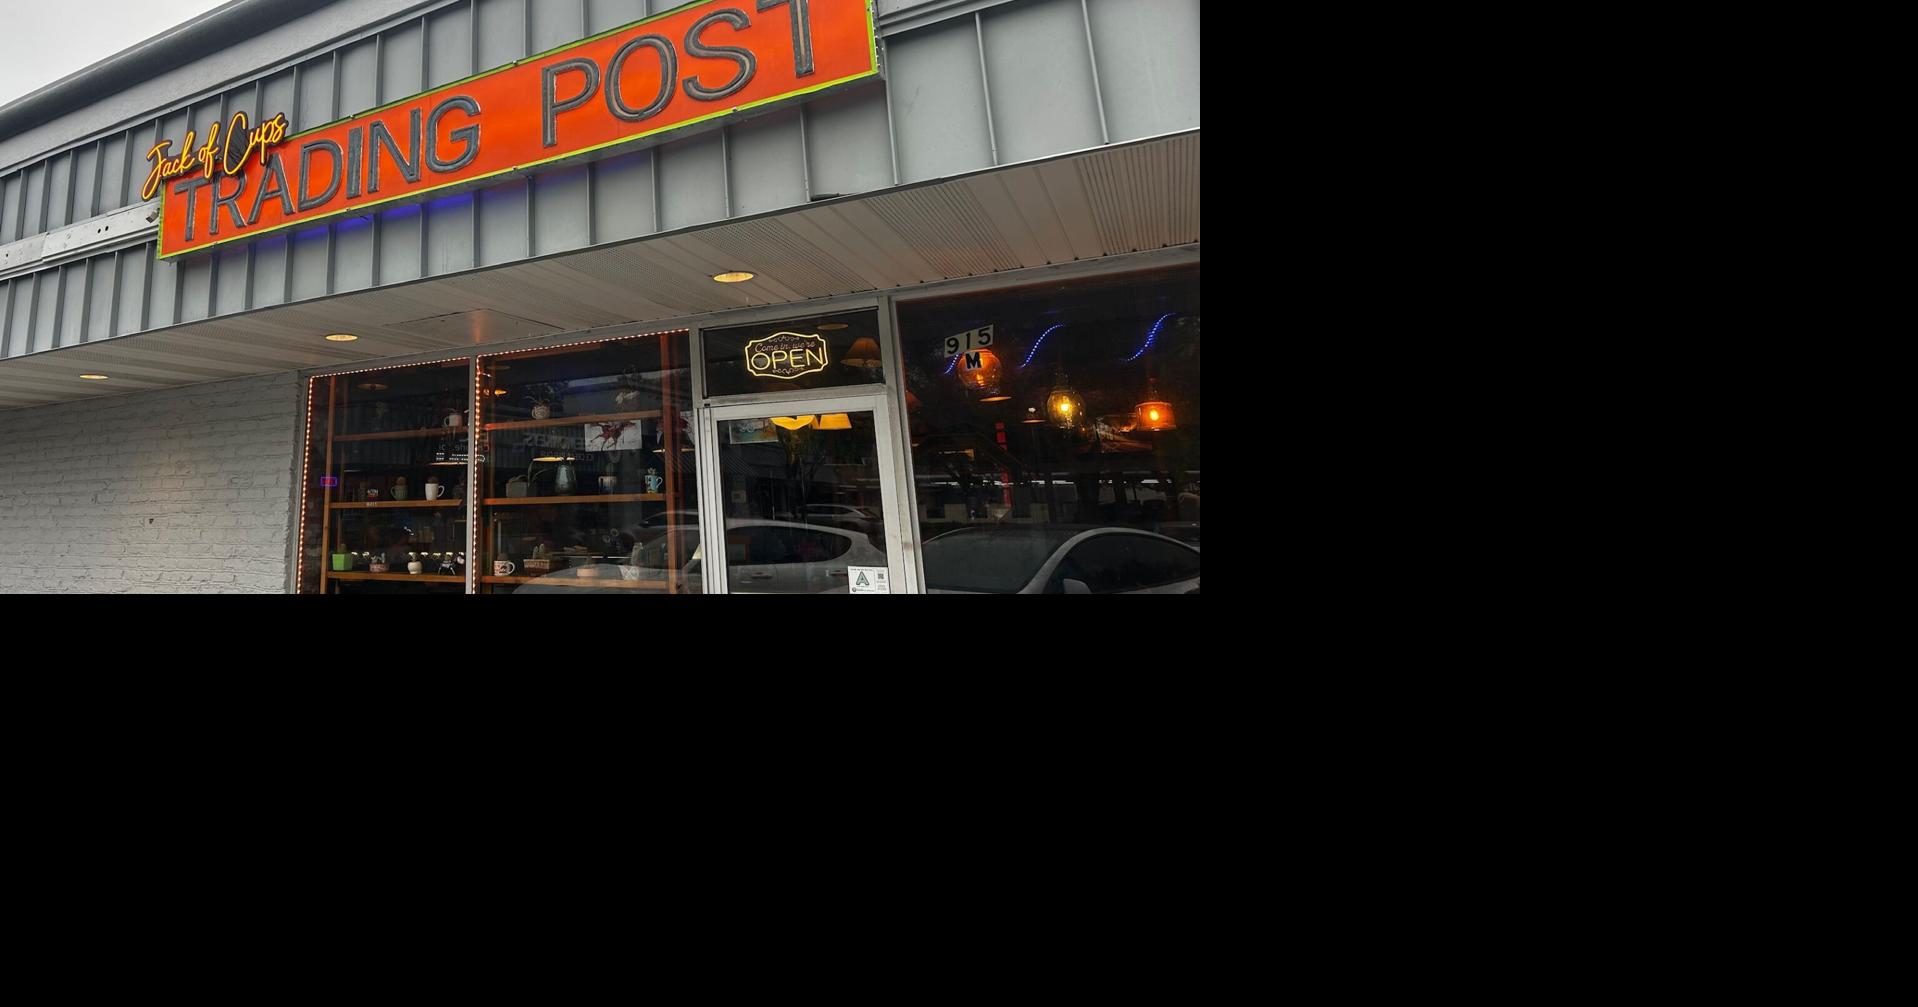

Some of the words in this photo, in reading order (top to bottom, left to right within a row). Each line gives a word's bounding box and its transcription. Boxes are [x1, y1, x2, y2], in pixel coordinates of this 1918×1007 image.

[174, 95, 481, 242] TRADING
[541, 0, 815, 147] POST
[141, 131, 195, 200] Jack
[199, 123, 218, 178] of
[223, 112, 287, 175] Cups
[754, 342, 779, 353] Come
[946, 327, 991, 354] 915
[751, 346, 824, 371] OPEN
[965, 352, 982, 369] M
[856, 571, 870, 585] A
